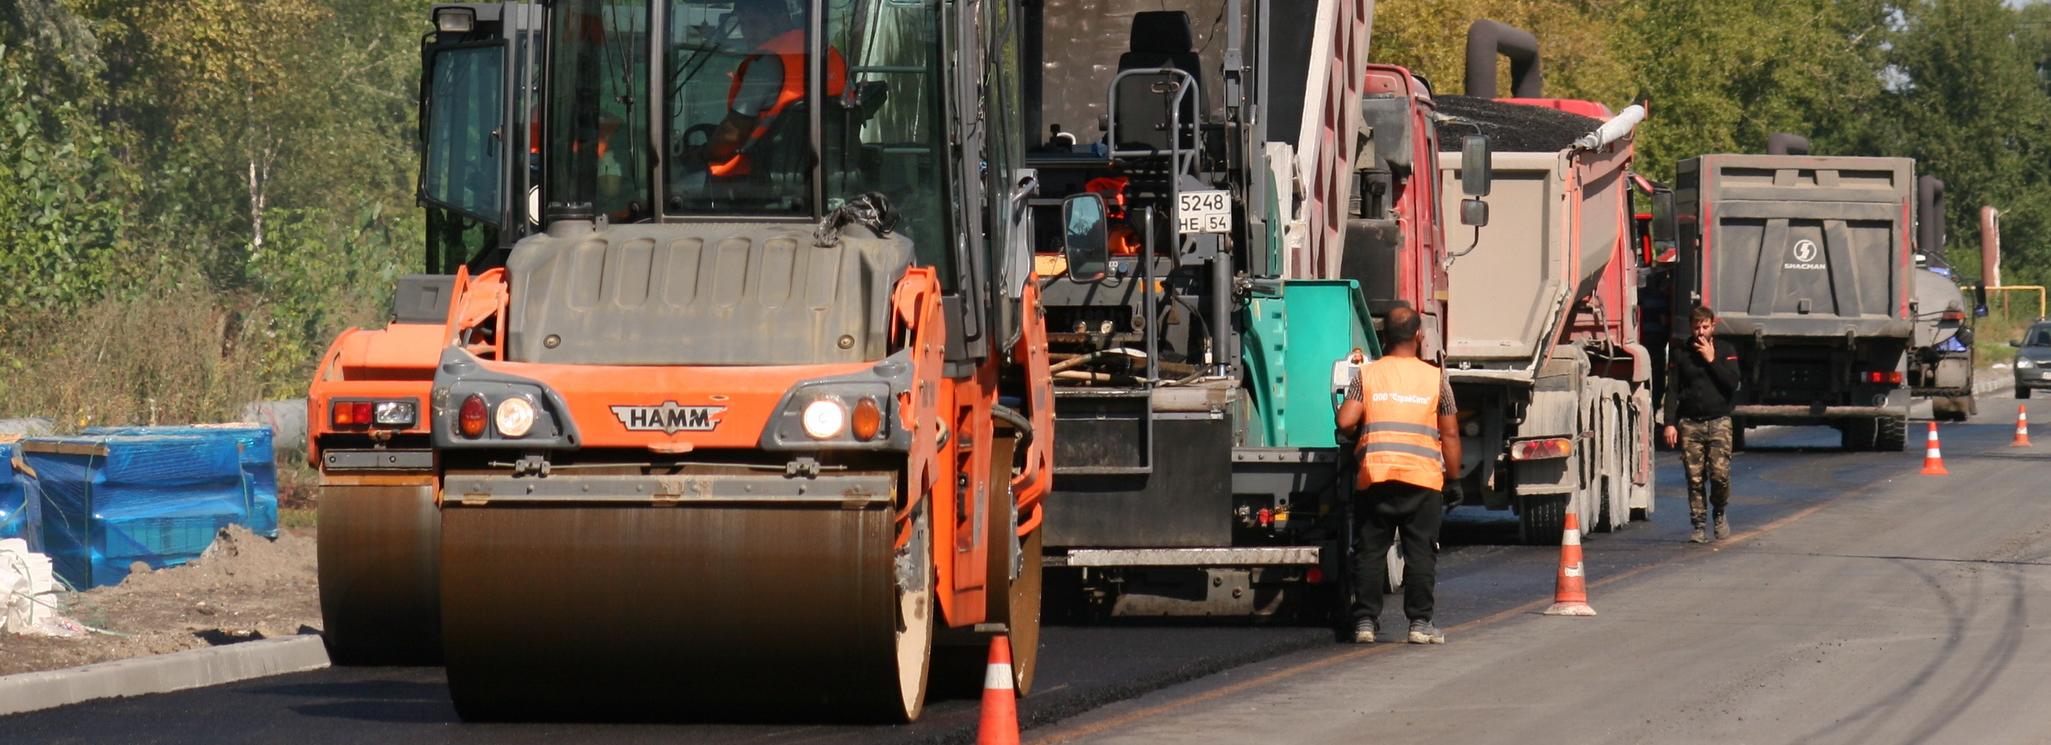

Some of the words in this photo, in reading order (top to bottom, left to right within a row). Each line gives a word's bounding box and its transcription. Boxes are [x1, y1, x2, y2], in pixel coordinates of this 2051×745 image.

[1181, 194, 1224, 212] 5248
[1210, 216, 1226, 230] 54
[630, 408, 710, 428] HAMM
